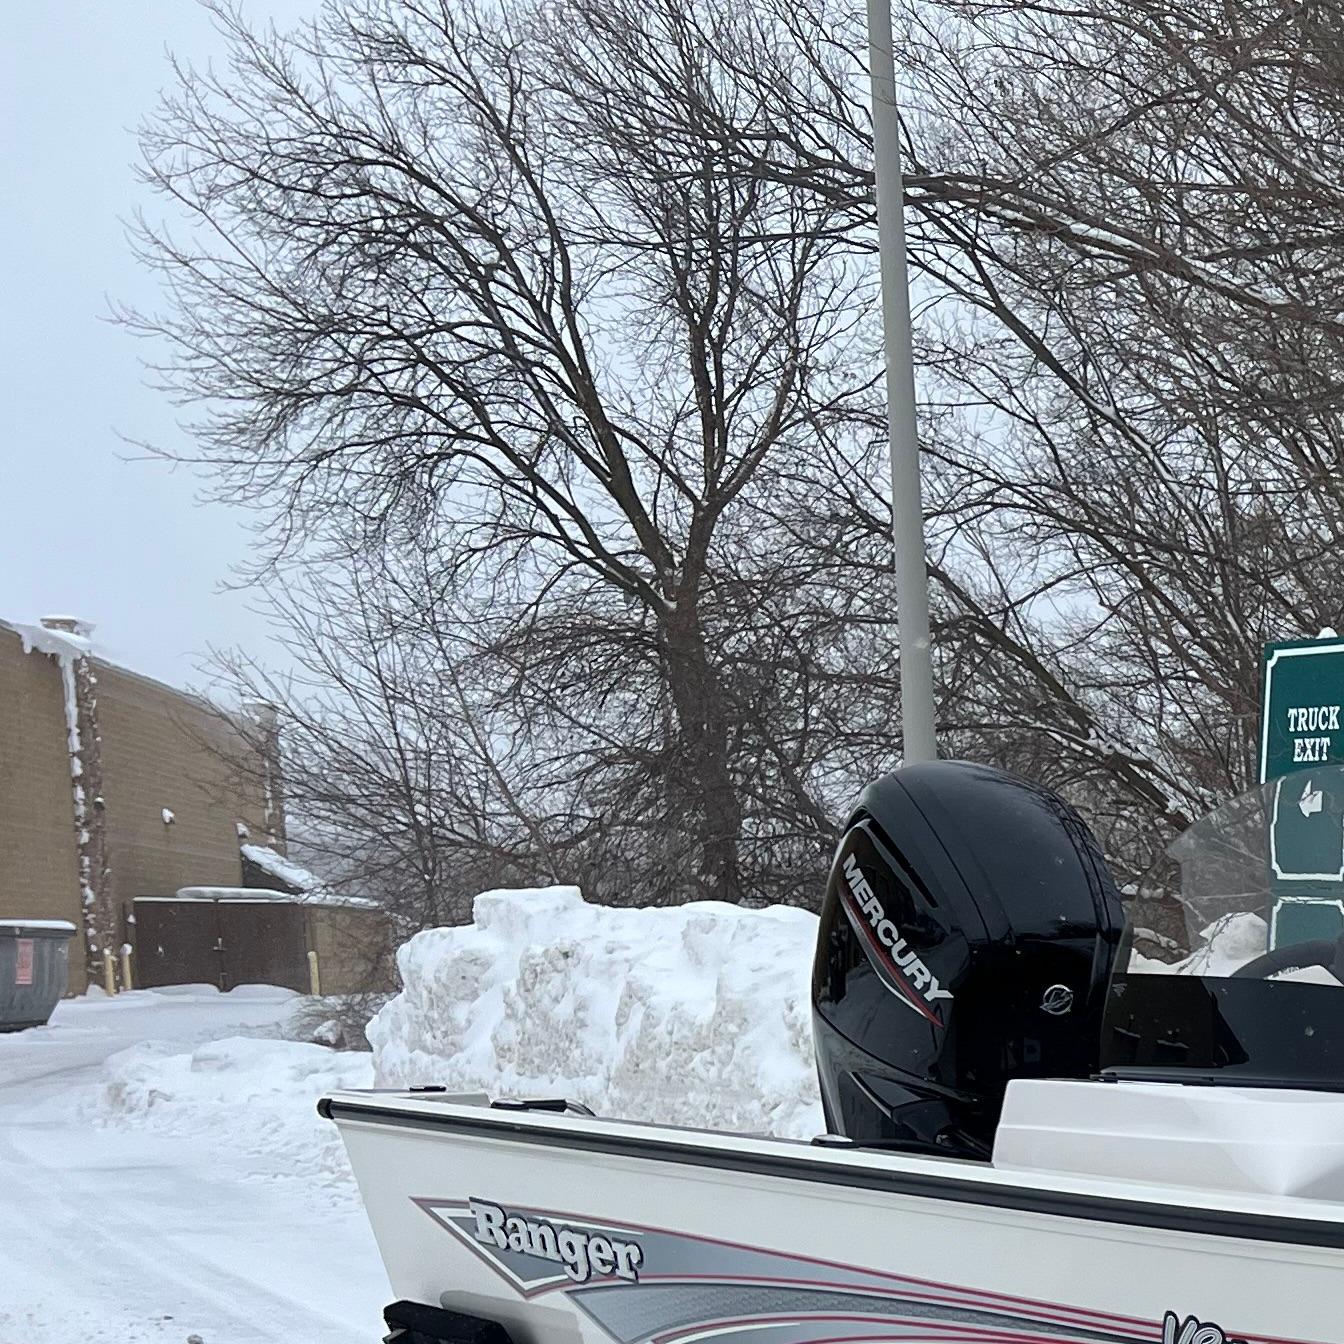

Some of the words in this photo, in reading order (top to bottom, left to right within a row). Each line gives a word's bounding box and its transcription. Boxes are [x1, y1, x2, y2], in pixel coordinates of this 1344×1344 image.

[1288, 705, 1341, 732] TRUCK
[1293, 737, 1331, 762] EXIT
[842, 852, 955, 1003] MERCURY
[469, 1196, 644, 1284] Ranger
